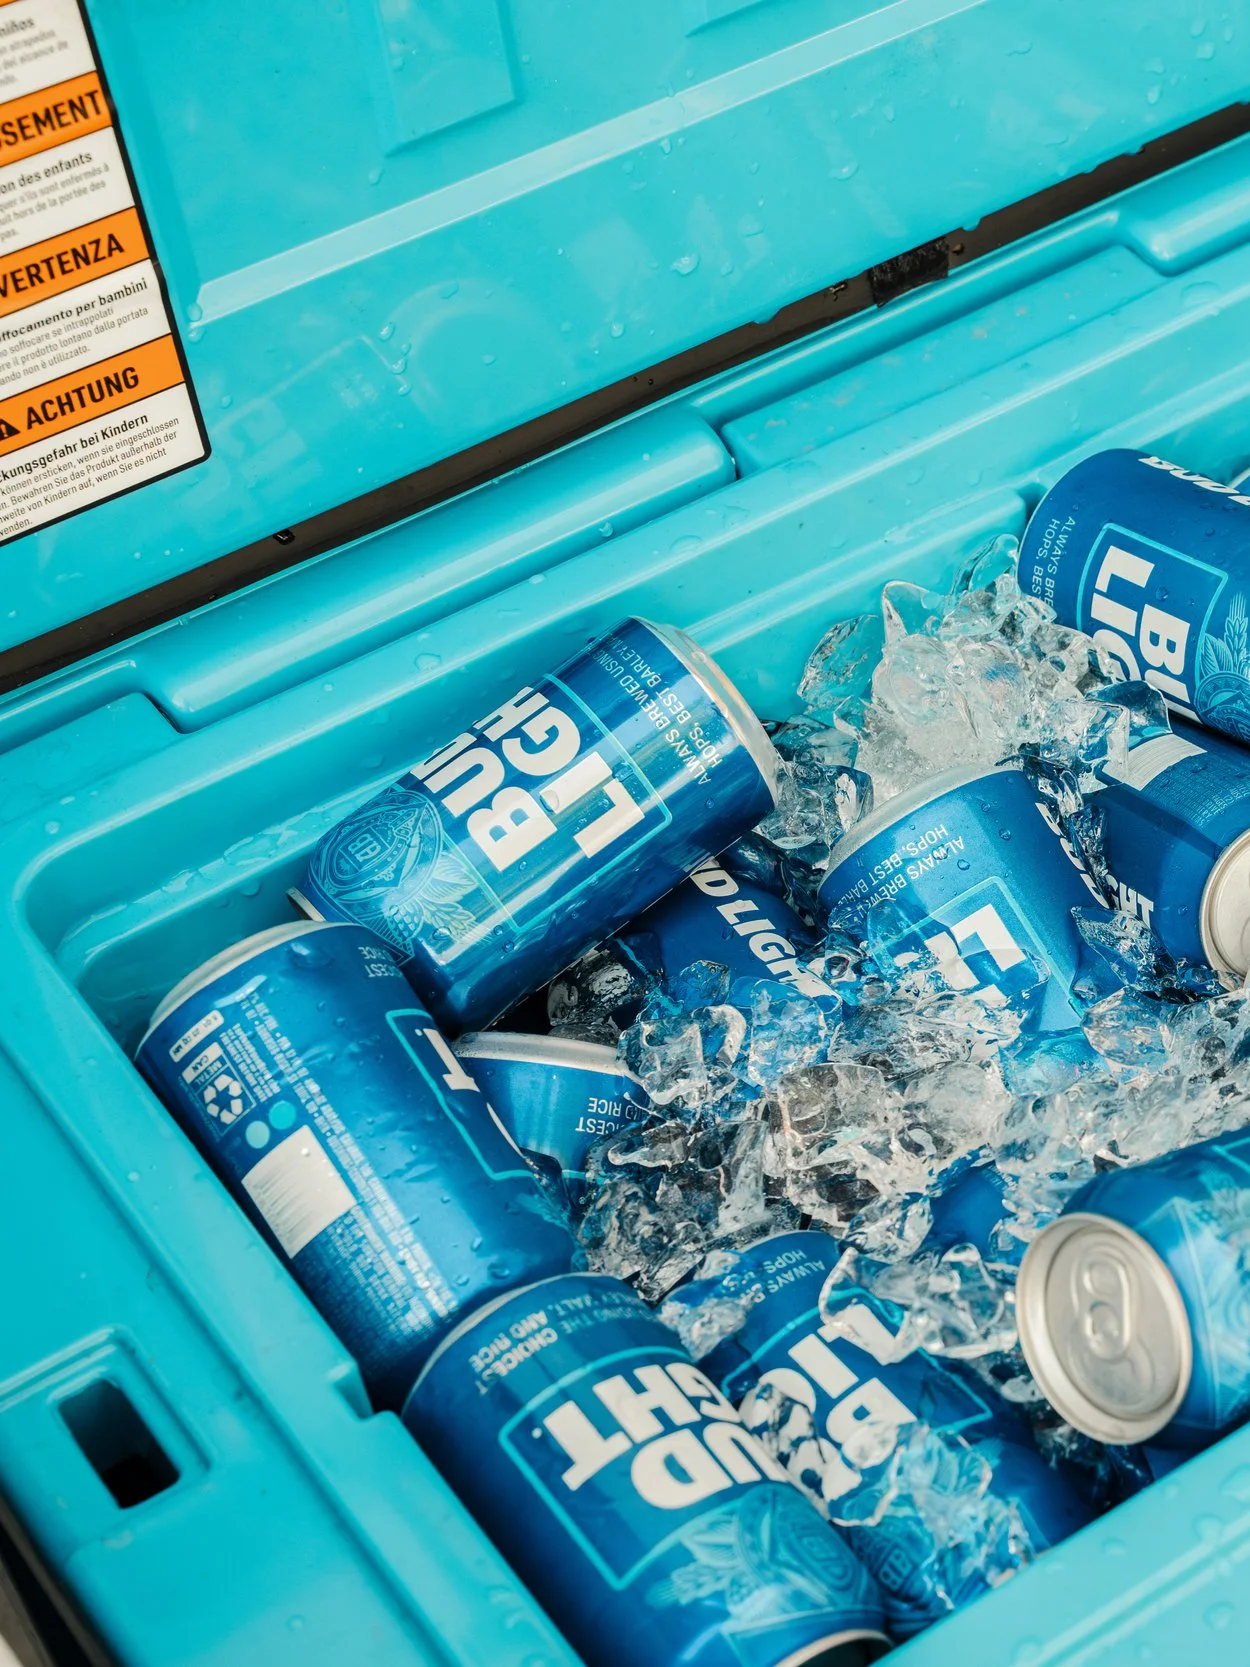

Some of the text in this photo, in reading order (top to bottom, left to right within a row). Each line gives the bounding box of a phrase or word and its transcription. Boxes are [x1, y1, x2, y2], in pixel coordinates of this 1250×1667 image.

[0, 89, 100, 147] SEMENT
[18, 172, 42, 187] des
[44, 153, 93, 178] enfants
[0, 277, 148, 342] ffocamento per bambini
[9, 333, 51, 354] soffocare
[51, 327, 63, 337] se
[63, 307, 115, 333] intrappolati
[21, 344, 59, 366] prodotto
[59, 330, 93, 348] lontano
[93, 318, 116, 335] dalla
[116, 306, 149, 325] portata
[23, 364, 40, 377] non
[48, 344, 91, 367] utilizzato.
[26, 366, 140, 430] ACHTUNG
[79, 432, 100, 450] bei
[101, 414, 149, 440] Kindern
[1, 417, 180, 496] können ersticken, wenn sie eingeschlossen
[11, 482, 54, 506] Bewahren
[54, 475, 69, 489] Sie
[69, 468, 86, 482] das
[86, 453, 120, 475] Produkt
[120, 438, 163, 460] außerhalb
[163, 430, 178, 443] der
[27, 500, 43, 512] von
[44, 487, 78, 505] Kindern
[78, 478, 95, 492] auf,
[95, 469, 119, 484] wenn
[119, 462, 133, 475] Sie
[134, 458, 145, 468] es
[145, 447, 168, 464] nicht
[1031, 565, 1044, 599] BES
[1044, 516, 1076, 608] ALWAYS BRE
[1090, 545, 1156, 682] LIG
[1139, 604, 1204, 725] BU
[619, 674, 671, 730] BREWED
[656, 687, 692, 724] BEST
[665, 728, 711, 785] ALWAYS
[689, 722, 723, 768] HOPS,
[472, 686, 645, 859] LIGH
[901, 823, 949, 857] HOPS,
[906, 835, 965, 880] ALWAYS
[868, 853, 903, 886] BEST
[191, 1055, 210, 1074] CAN
[587, 1097, 622, 1117] RICE
[769, 1259, 826, 1293] ALWAYS
[509, 1311, 548, 1339] AND
[560, 1313, 594, 1335] THE
[469, 1333, 512, 1373] RICE
[532, 1362, 742, 1492] GHT.
[631, 1421, 790, 1510] UD
